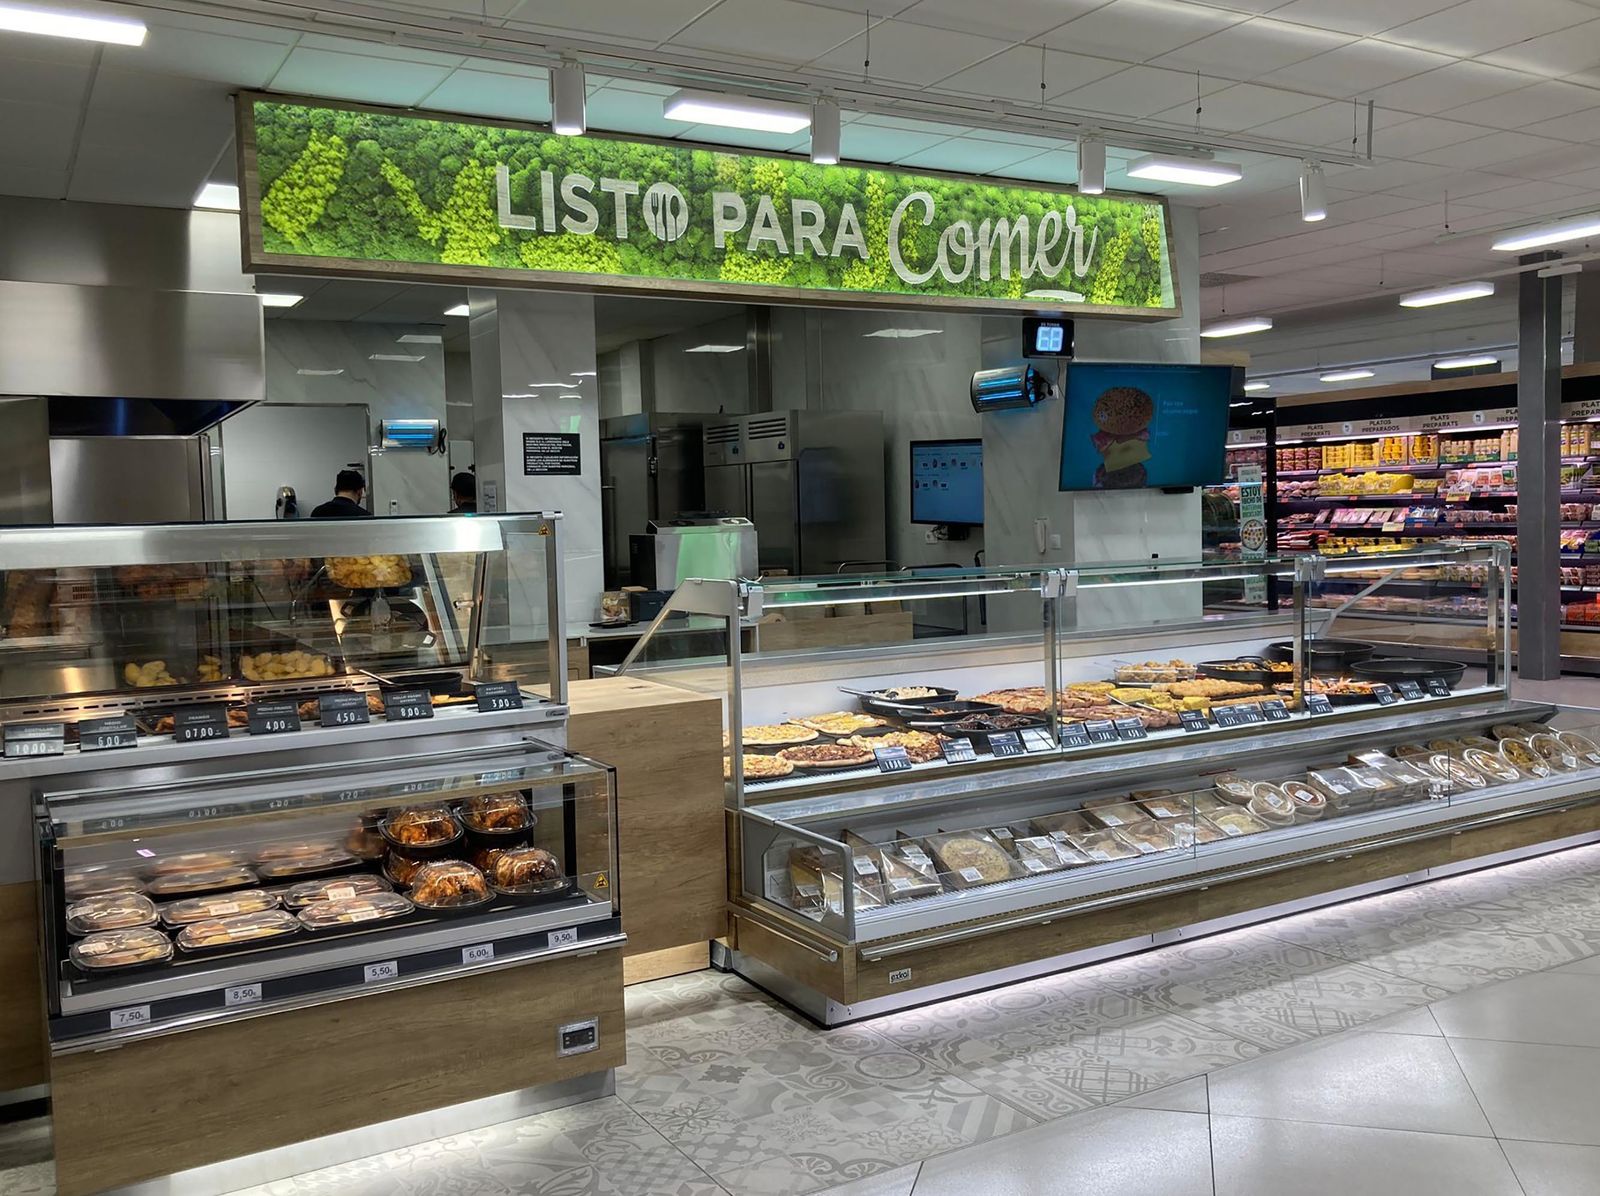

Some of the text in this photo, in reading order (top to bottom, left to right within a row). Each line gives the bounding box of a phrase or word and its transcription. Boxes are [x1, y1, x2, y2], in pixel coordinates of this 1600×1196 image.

[495, 165, 1099, 285] LISTO PARA Comer
[1423, 420, 1458, 428] PREPARATS
[1362, 425, 1400, 433] PREPARADOS
[1241, 487, 1261, 498] ESTOY
